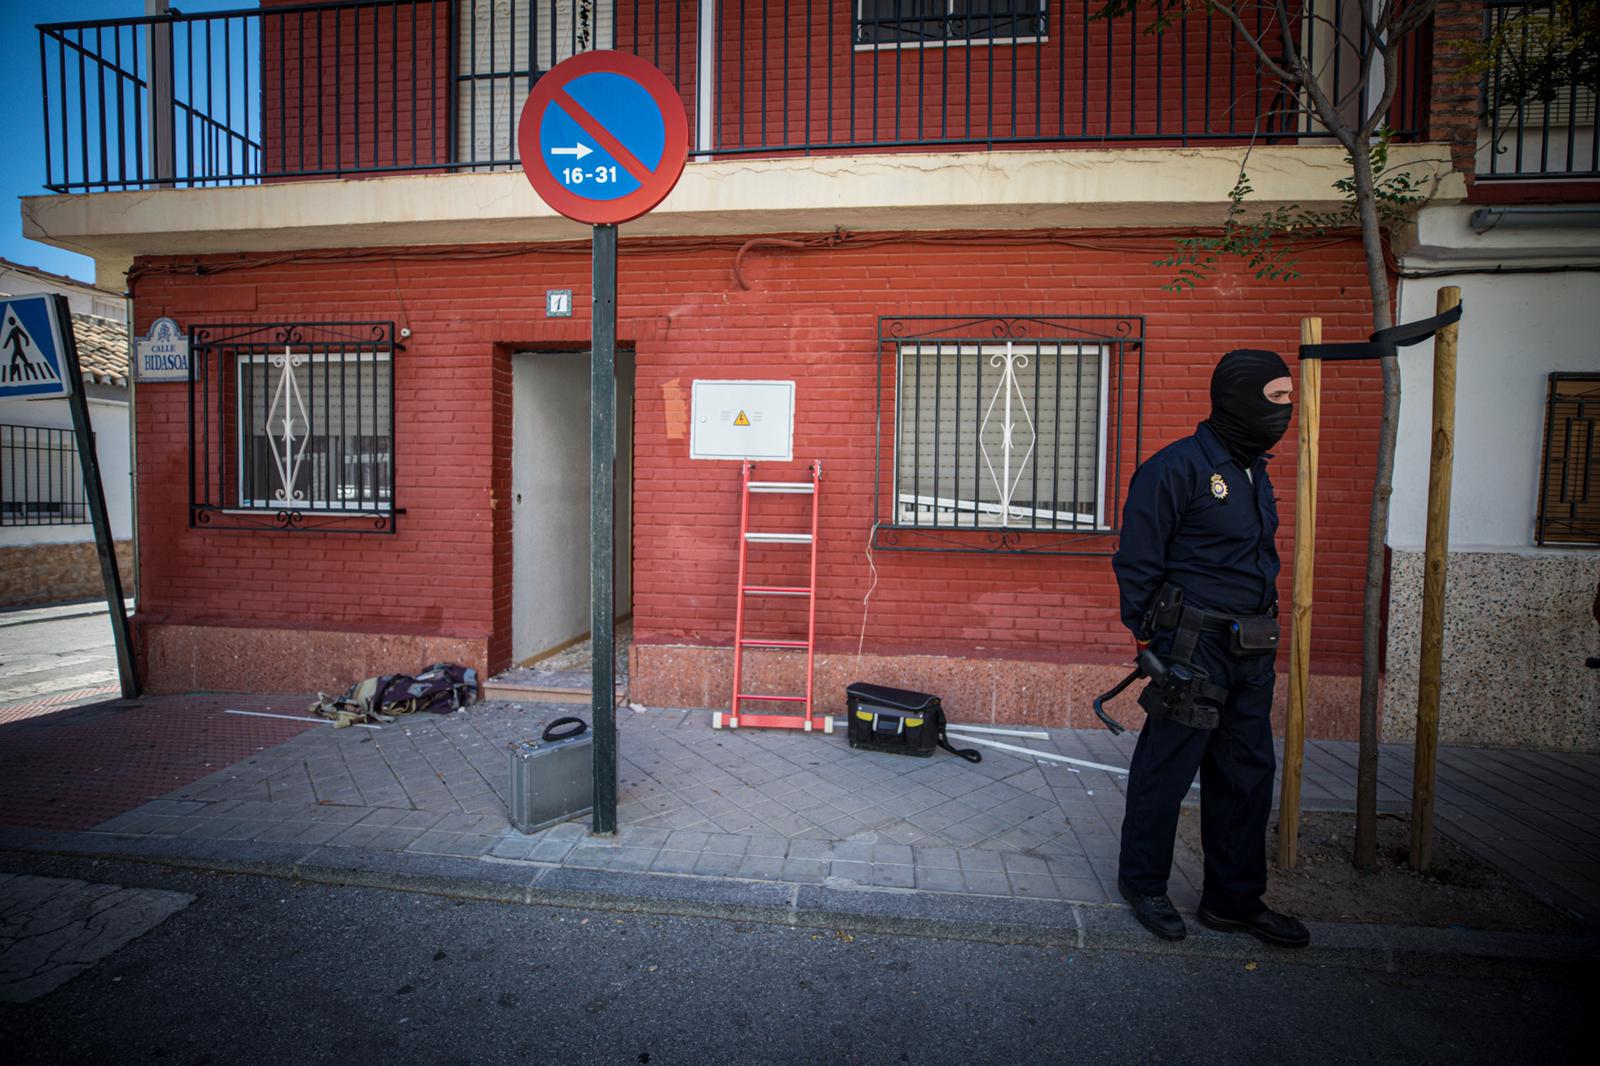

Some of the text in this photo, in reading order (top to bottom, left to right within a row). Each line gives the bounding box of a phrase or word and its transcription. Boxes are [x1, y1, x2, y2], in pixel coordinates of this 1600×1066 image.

[563, 166, 616, 184] 16-31
[554, 295, 562, 311] 1
[151, 344, 176, 353] CALLE
[144, 354, 189, 371] BIDASOA
